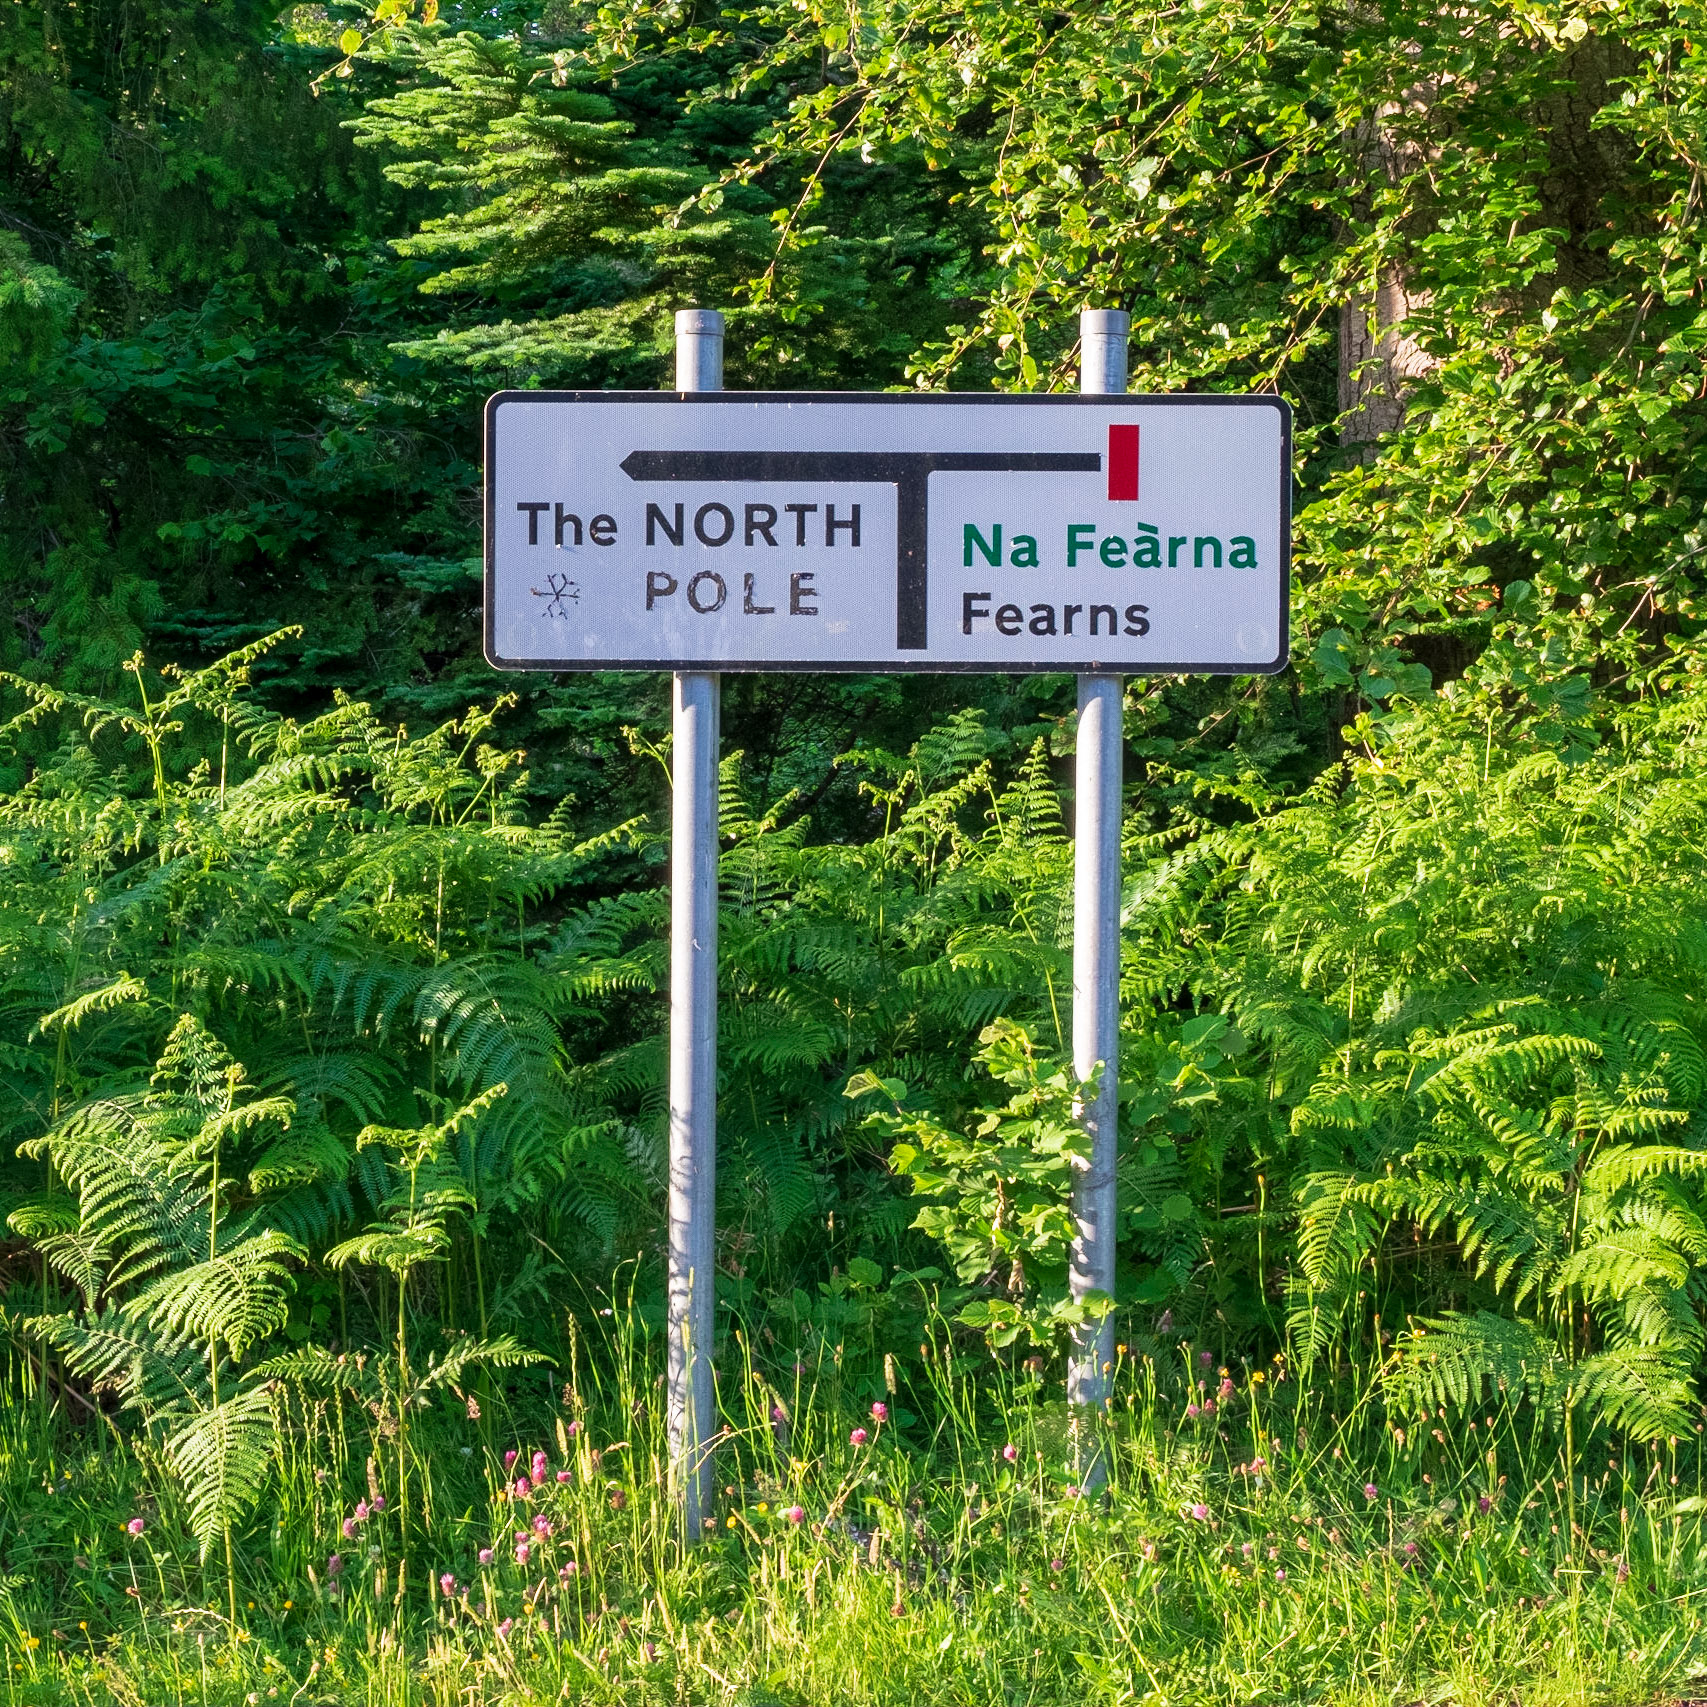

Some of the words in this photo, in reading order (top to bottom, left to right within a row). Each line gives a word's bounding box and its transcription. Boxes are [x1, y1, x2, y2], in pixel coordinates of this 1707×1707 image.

[516, 502, 618, 547] The
[645, 502, 861, 548] NORTH
[963, 523, 1040, 569] Na
[1066, 521, 1260, 570] Feàrna
[645, 570, 819, 616] POLE
[962, 592, 1151, 637] Fearns
